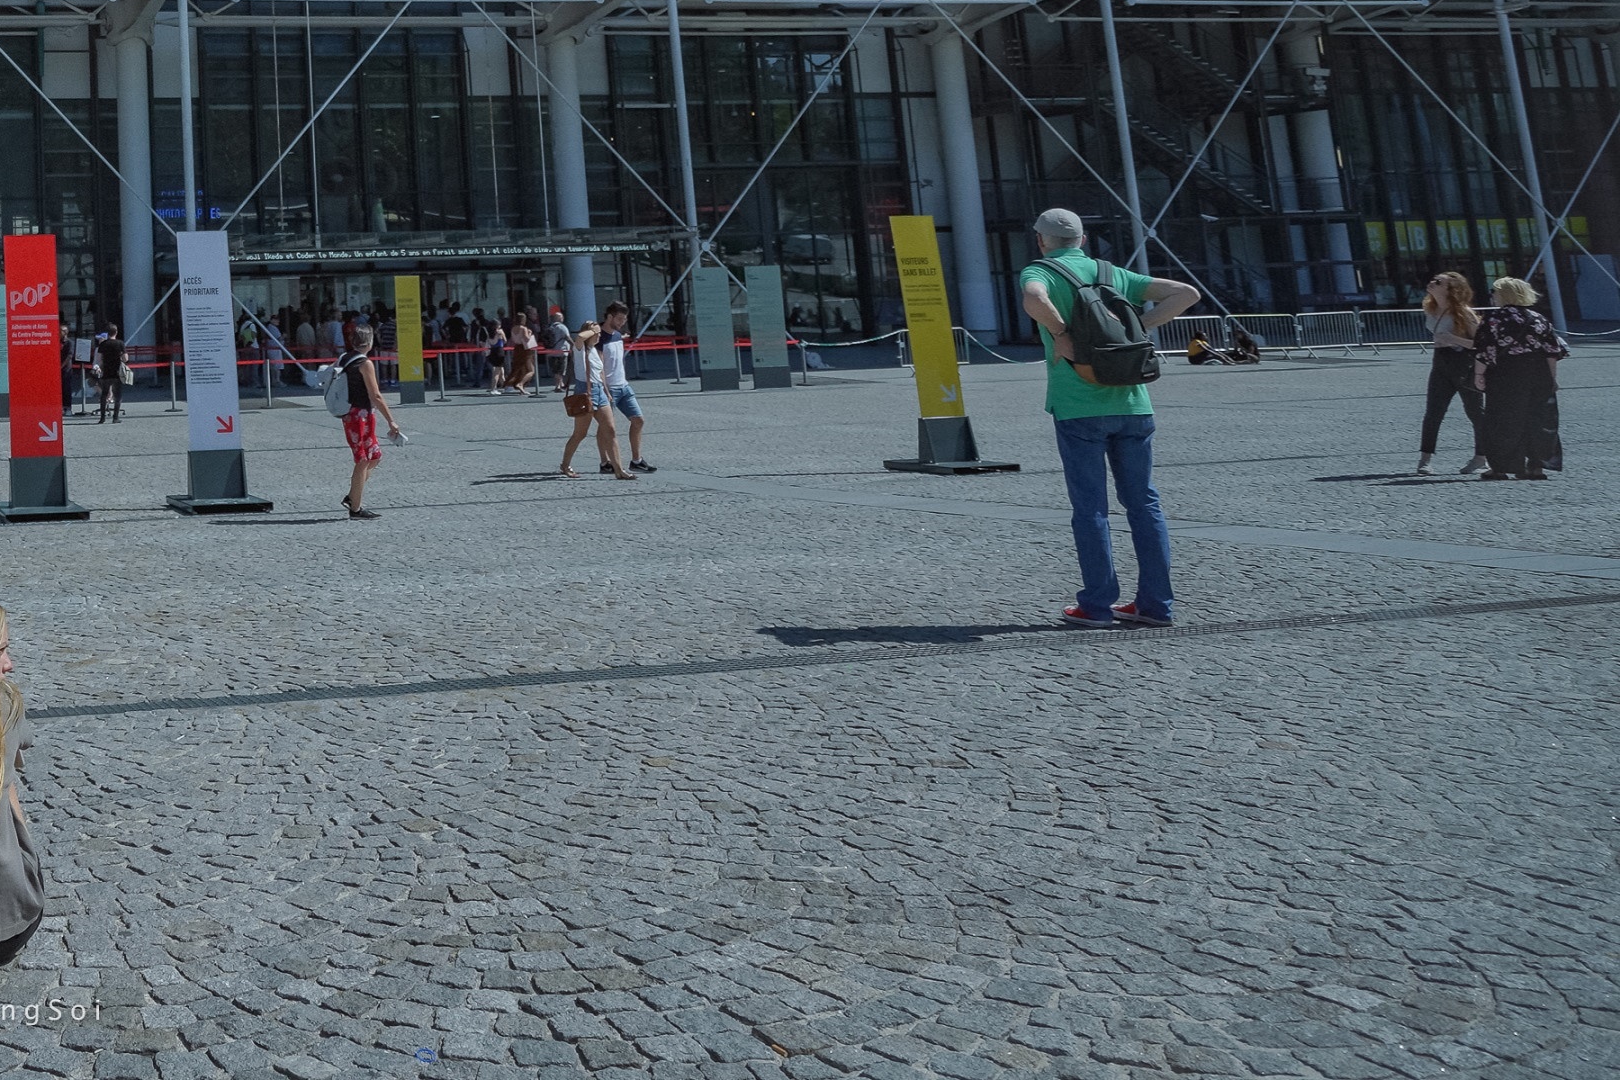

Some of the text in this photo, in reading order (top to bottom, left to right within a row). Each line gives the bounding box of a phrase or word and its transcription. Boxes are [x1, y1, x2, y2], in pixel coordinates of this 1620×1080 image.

[1394, 224, 1510, 252] LIBRAIRIE
[432, 248, 455, 256] ferait
[602, 244, 610, 252] de
[900, 257, 929, 265] VISITEURS
[902, 267, 936, 276] SANS BILLET
[183, 287, 219, 296] PRIORITAIRE
